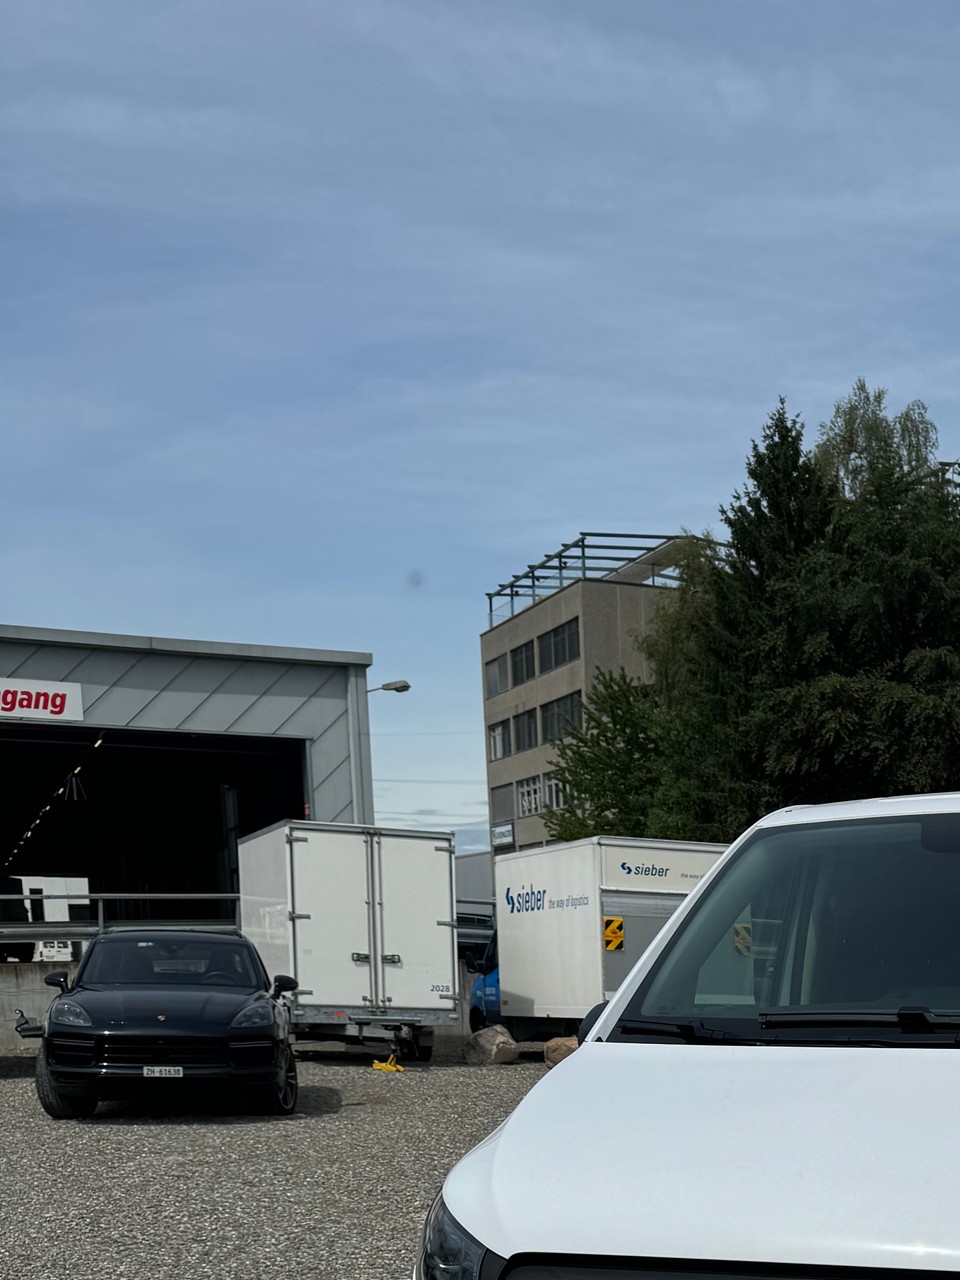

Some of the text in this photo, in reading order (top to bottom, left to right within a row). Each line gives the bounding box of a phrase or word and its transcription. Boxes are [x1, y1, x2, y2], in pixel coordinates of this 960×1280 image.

[0, 689, 67, 715] gang
[634, 863, 670, 877] sieber
[516, 883, 547, 913] sieber
[430, 984, 451, 993] 2028
